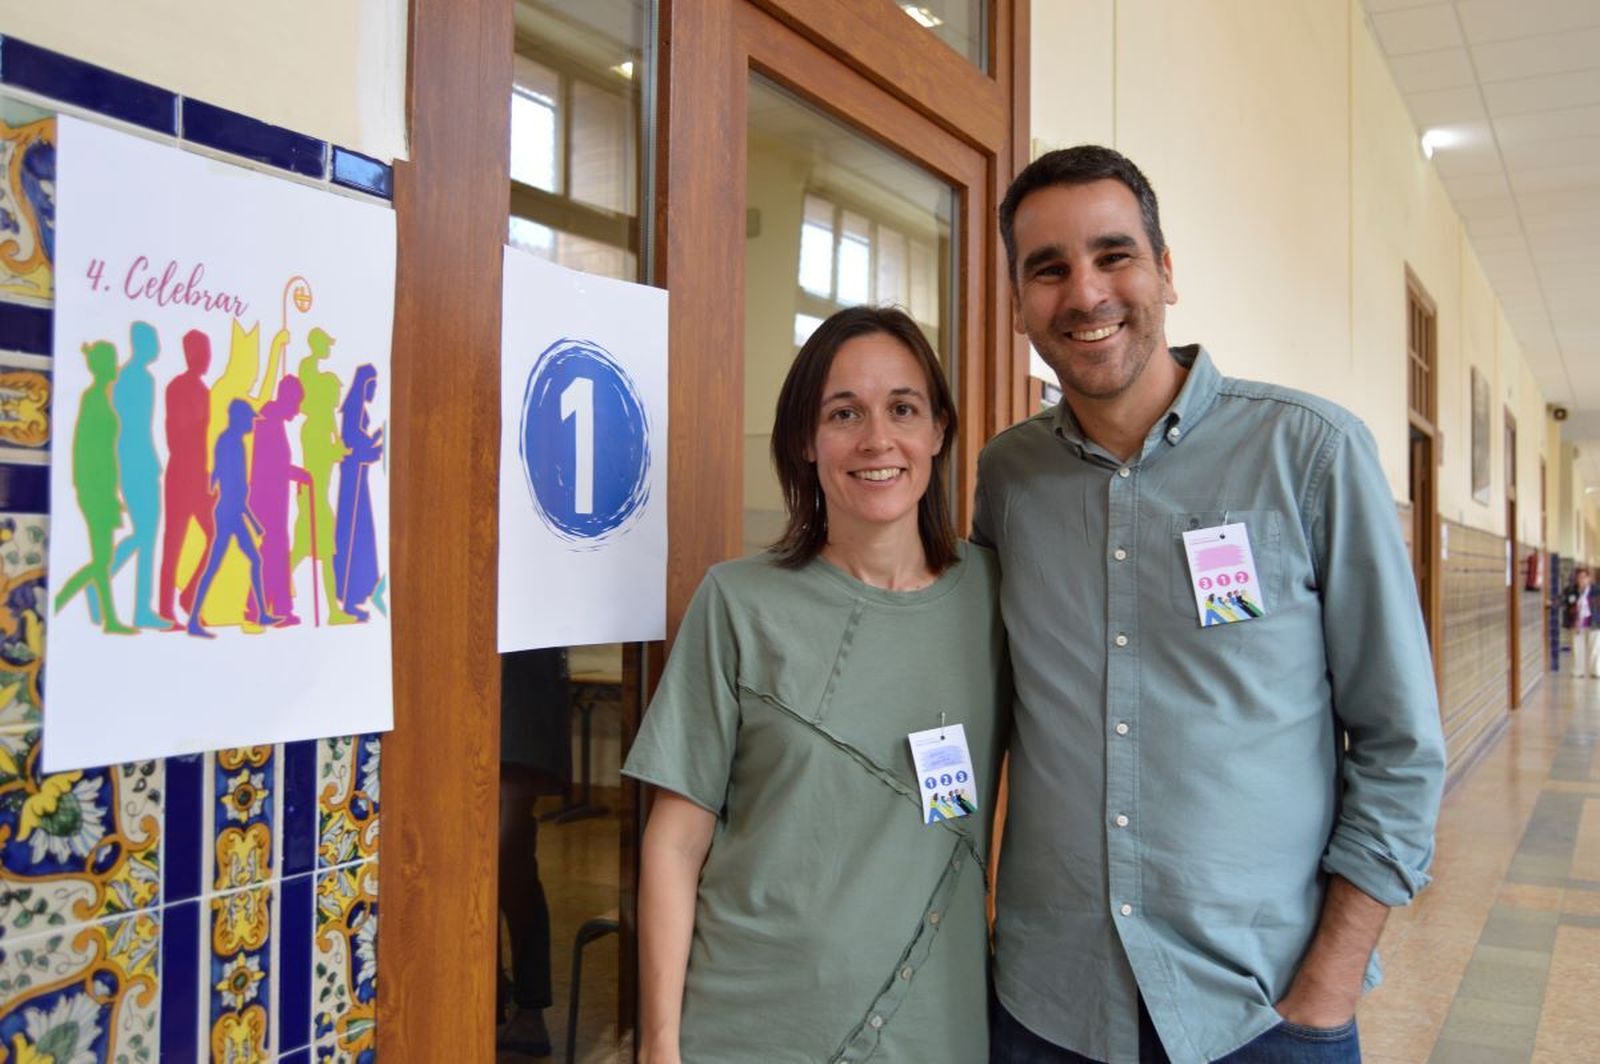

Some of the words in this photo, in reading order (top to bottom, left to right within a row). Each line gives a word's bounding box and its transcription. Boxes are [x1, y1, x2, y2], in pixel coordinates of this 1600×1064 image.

[86, 258, 110, 292] 4.
[124, 255, 249, 318] Celebrar
[560, 376, 594, 515] 1
